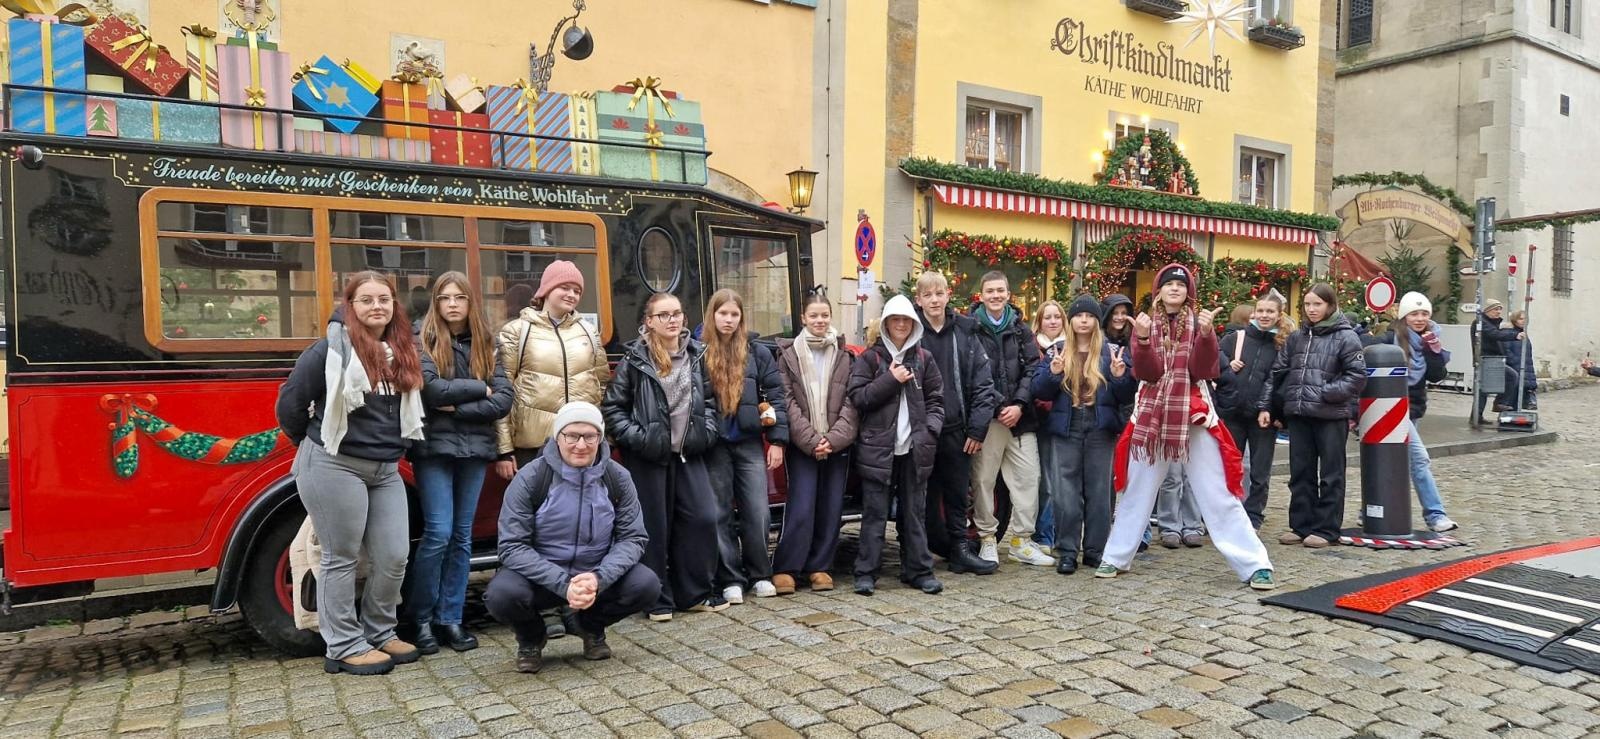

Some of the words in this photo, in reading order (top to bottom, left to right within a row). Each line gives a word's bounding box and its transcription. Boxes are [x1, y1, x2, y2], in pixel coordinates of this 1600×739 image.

[1131, 85, 1204, 114] WOHLFAHRT
[153, 157, 221, 182] Freude
[225, 166, 297, 186] bereiten
[300, 173, 335, 188] mit
[338, 170, 439, 194] Geschenken
[441, 186, 473, 197] von
[480, 184, 528, 200] Käthe
[531, 187, 608, 206] Wohlfahrt
